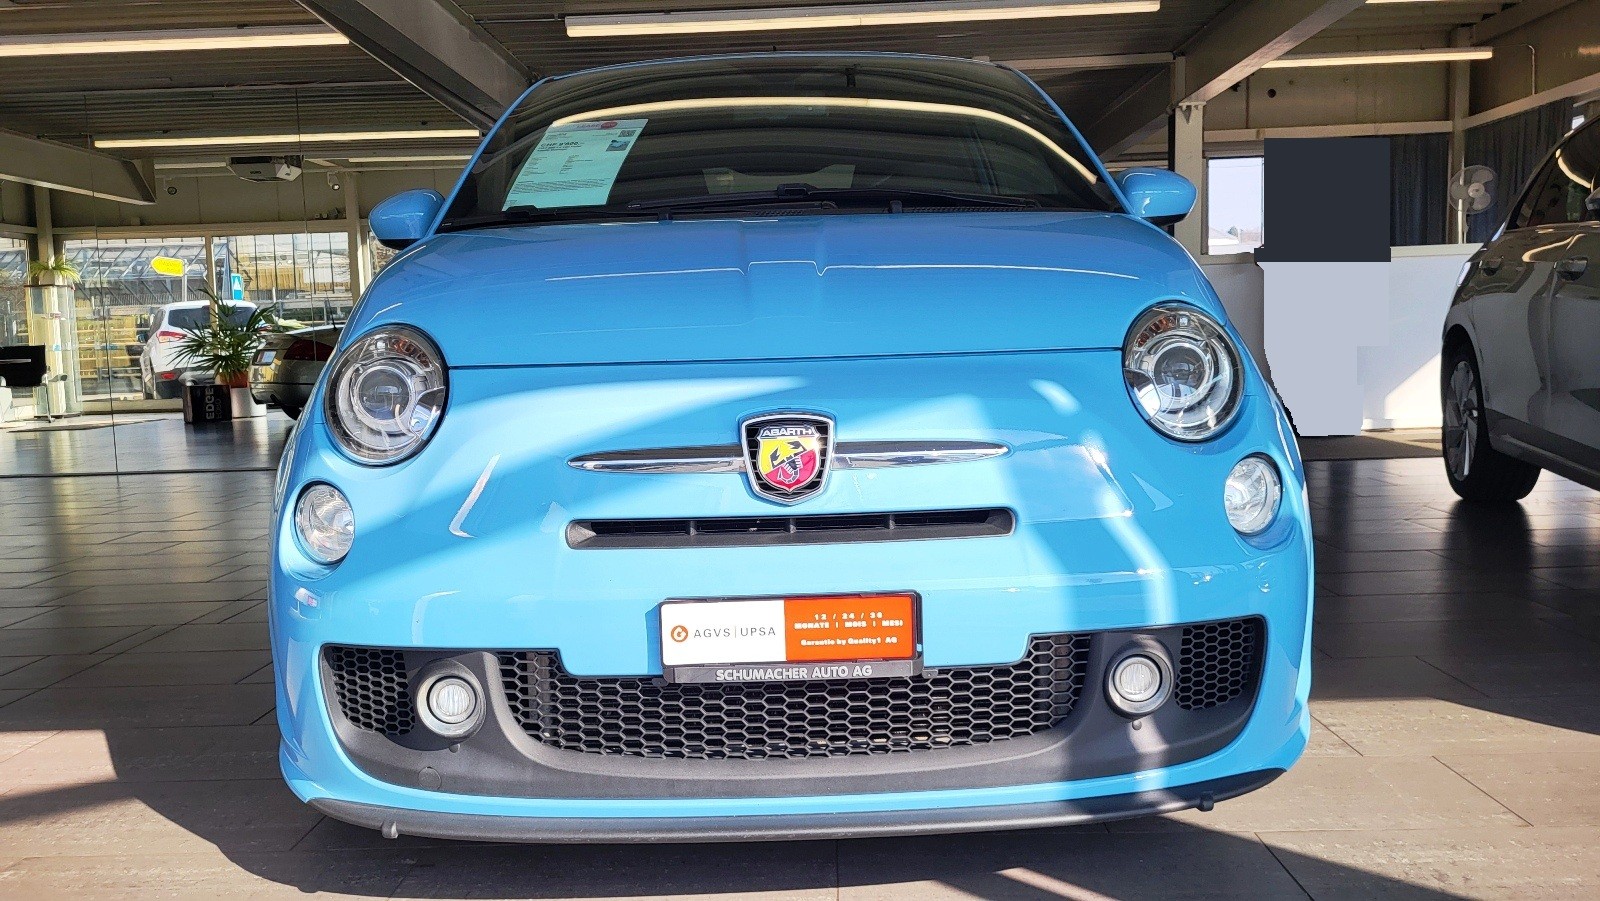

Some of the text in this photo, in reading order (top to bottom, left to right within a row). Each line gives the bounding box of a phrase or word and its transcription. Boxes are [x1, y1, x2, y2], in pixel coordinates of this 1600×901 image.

[205, 387, 214, 420] EDGE
[762, 428, 812, 437] ABARTH
[694, 626, 776, 638] AGVS UPSA
[794, 622, 830, 630] MONATE
[715, 664, 873, 682] SCHUMACHER AUTO AG
